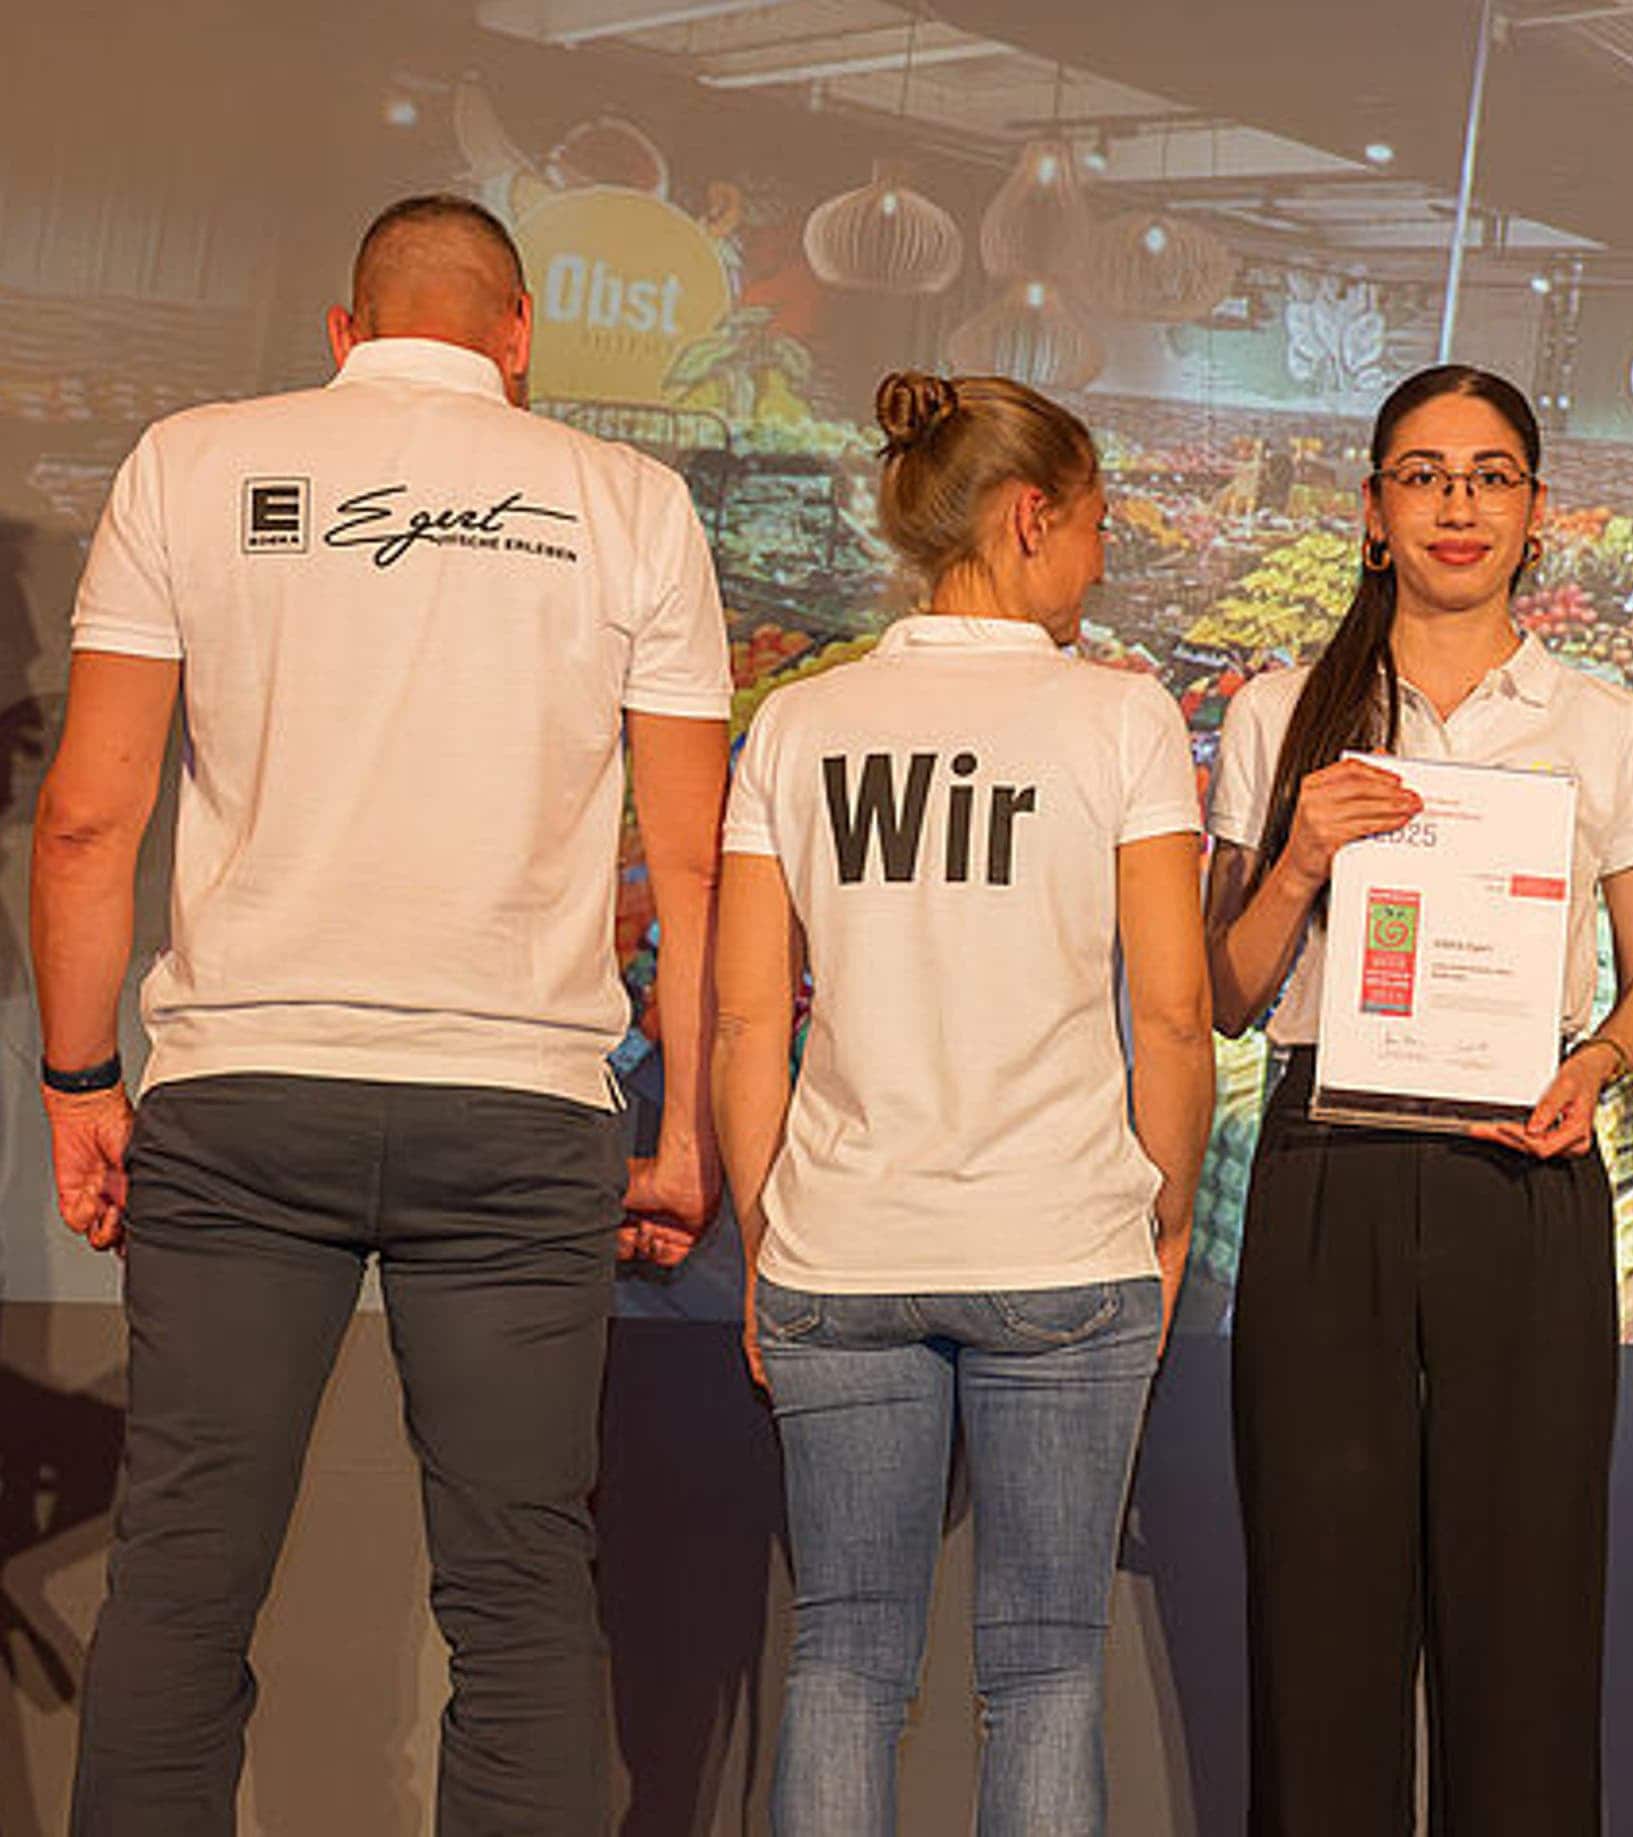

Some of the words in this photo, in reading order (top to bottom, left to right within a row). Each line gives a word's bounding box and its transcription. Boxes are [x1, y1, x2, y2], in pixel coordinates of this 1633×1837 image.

[545, 253, 683, 333] Obst
[323, 485, 577, 568] Egert
[821, 752, 1037, 886] Wir
